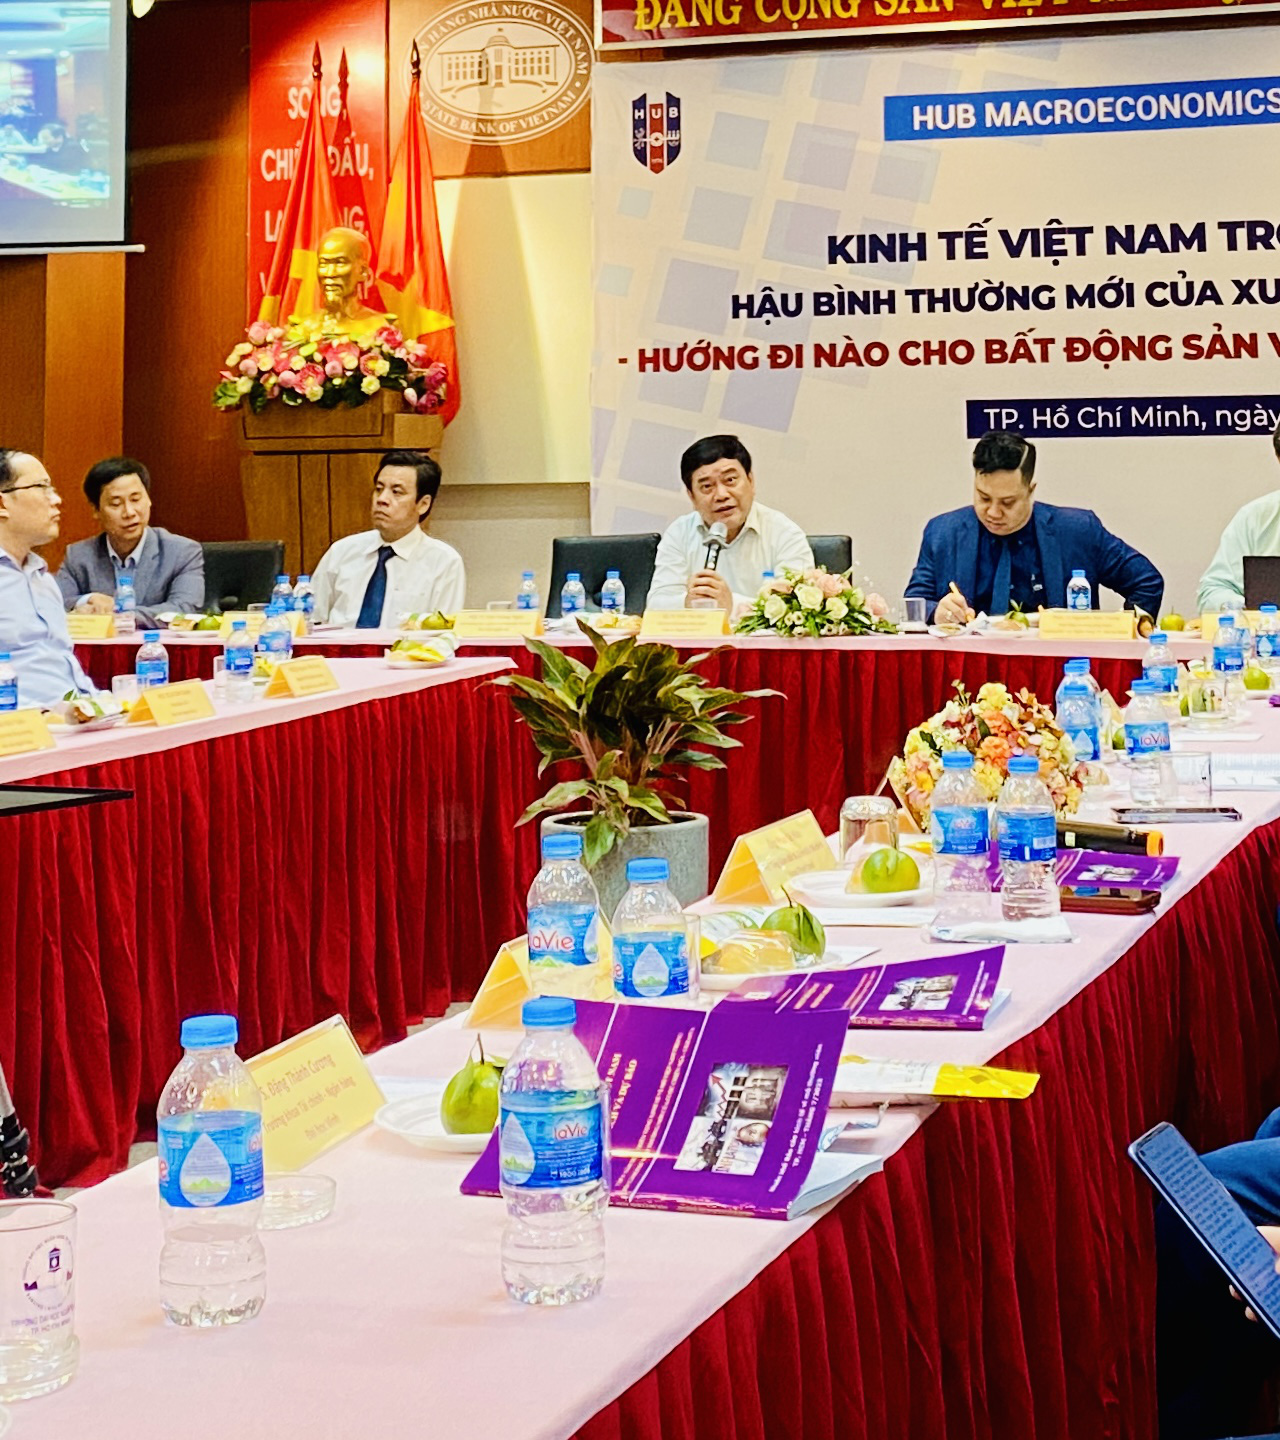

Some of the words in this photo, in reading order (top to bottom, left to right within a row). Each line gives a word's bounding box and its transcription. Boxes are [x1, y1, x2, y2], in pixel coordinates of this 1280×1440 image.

[546, 12, 577, 40] VIỆT
[573, 39, 588, 75] NAM
[424, 99, 458, 127] STATE
[460, 121, 496, 134] BANK
[499, 120, 519, 133] OF
[518, 90, 576, 128] VIETNAM
[634, 107, 679, 120] HUB
[913, 104, 975, 130] HUB
[827, 231, 928, 265] KINH
[938, 217, 992, 261] TẾ
[998, 218, 1094, 266] VIỆT
[1105, 221, 1208, 255] NAM
[731, 287, 804, 326] HẬU
[813, 282, 897, 316] BÌNH
[904, 277, 1056, 314] THƯỜNG
[1065, 276, 1135, 310] MỚI
[1144, 268, 1220, 308] CỦA
[637, 339, 759, 373] HƯỚNG
[767, 343, 805, 370] ĐI
[812, 334, 889, 369] NÀO
[897, 338, 975, 367] CHO
[985, 327, 1055, 365] BẤT
[1062, 328, 1174, 370] ĐỘNG
[1183, 323, 1258, 360] SẢN
[983, 408, 1024, 430] TP.
[1033, 404, 1069, 429] Hồ
[1077, 404, 1123, 428] Chí
[1130, 403, 1207, 431] Minh,
